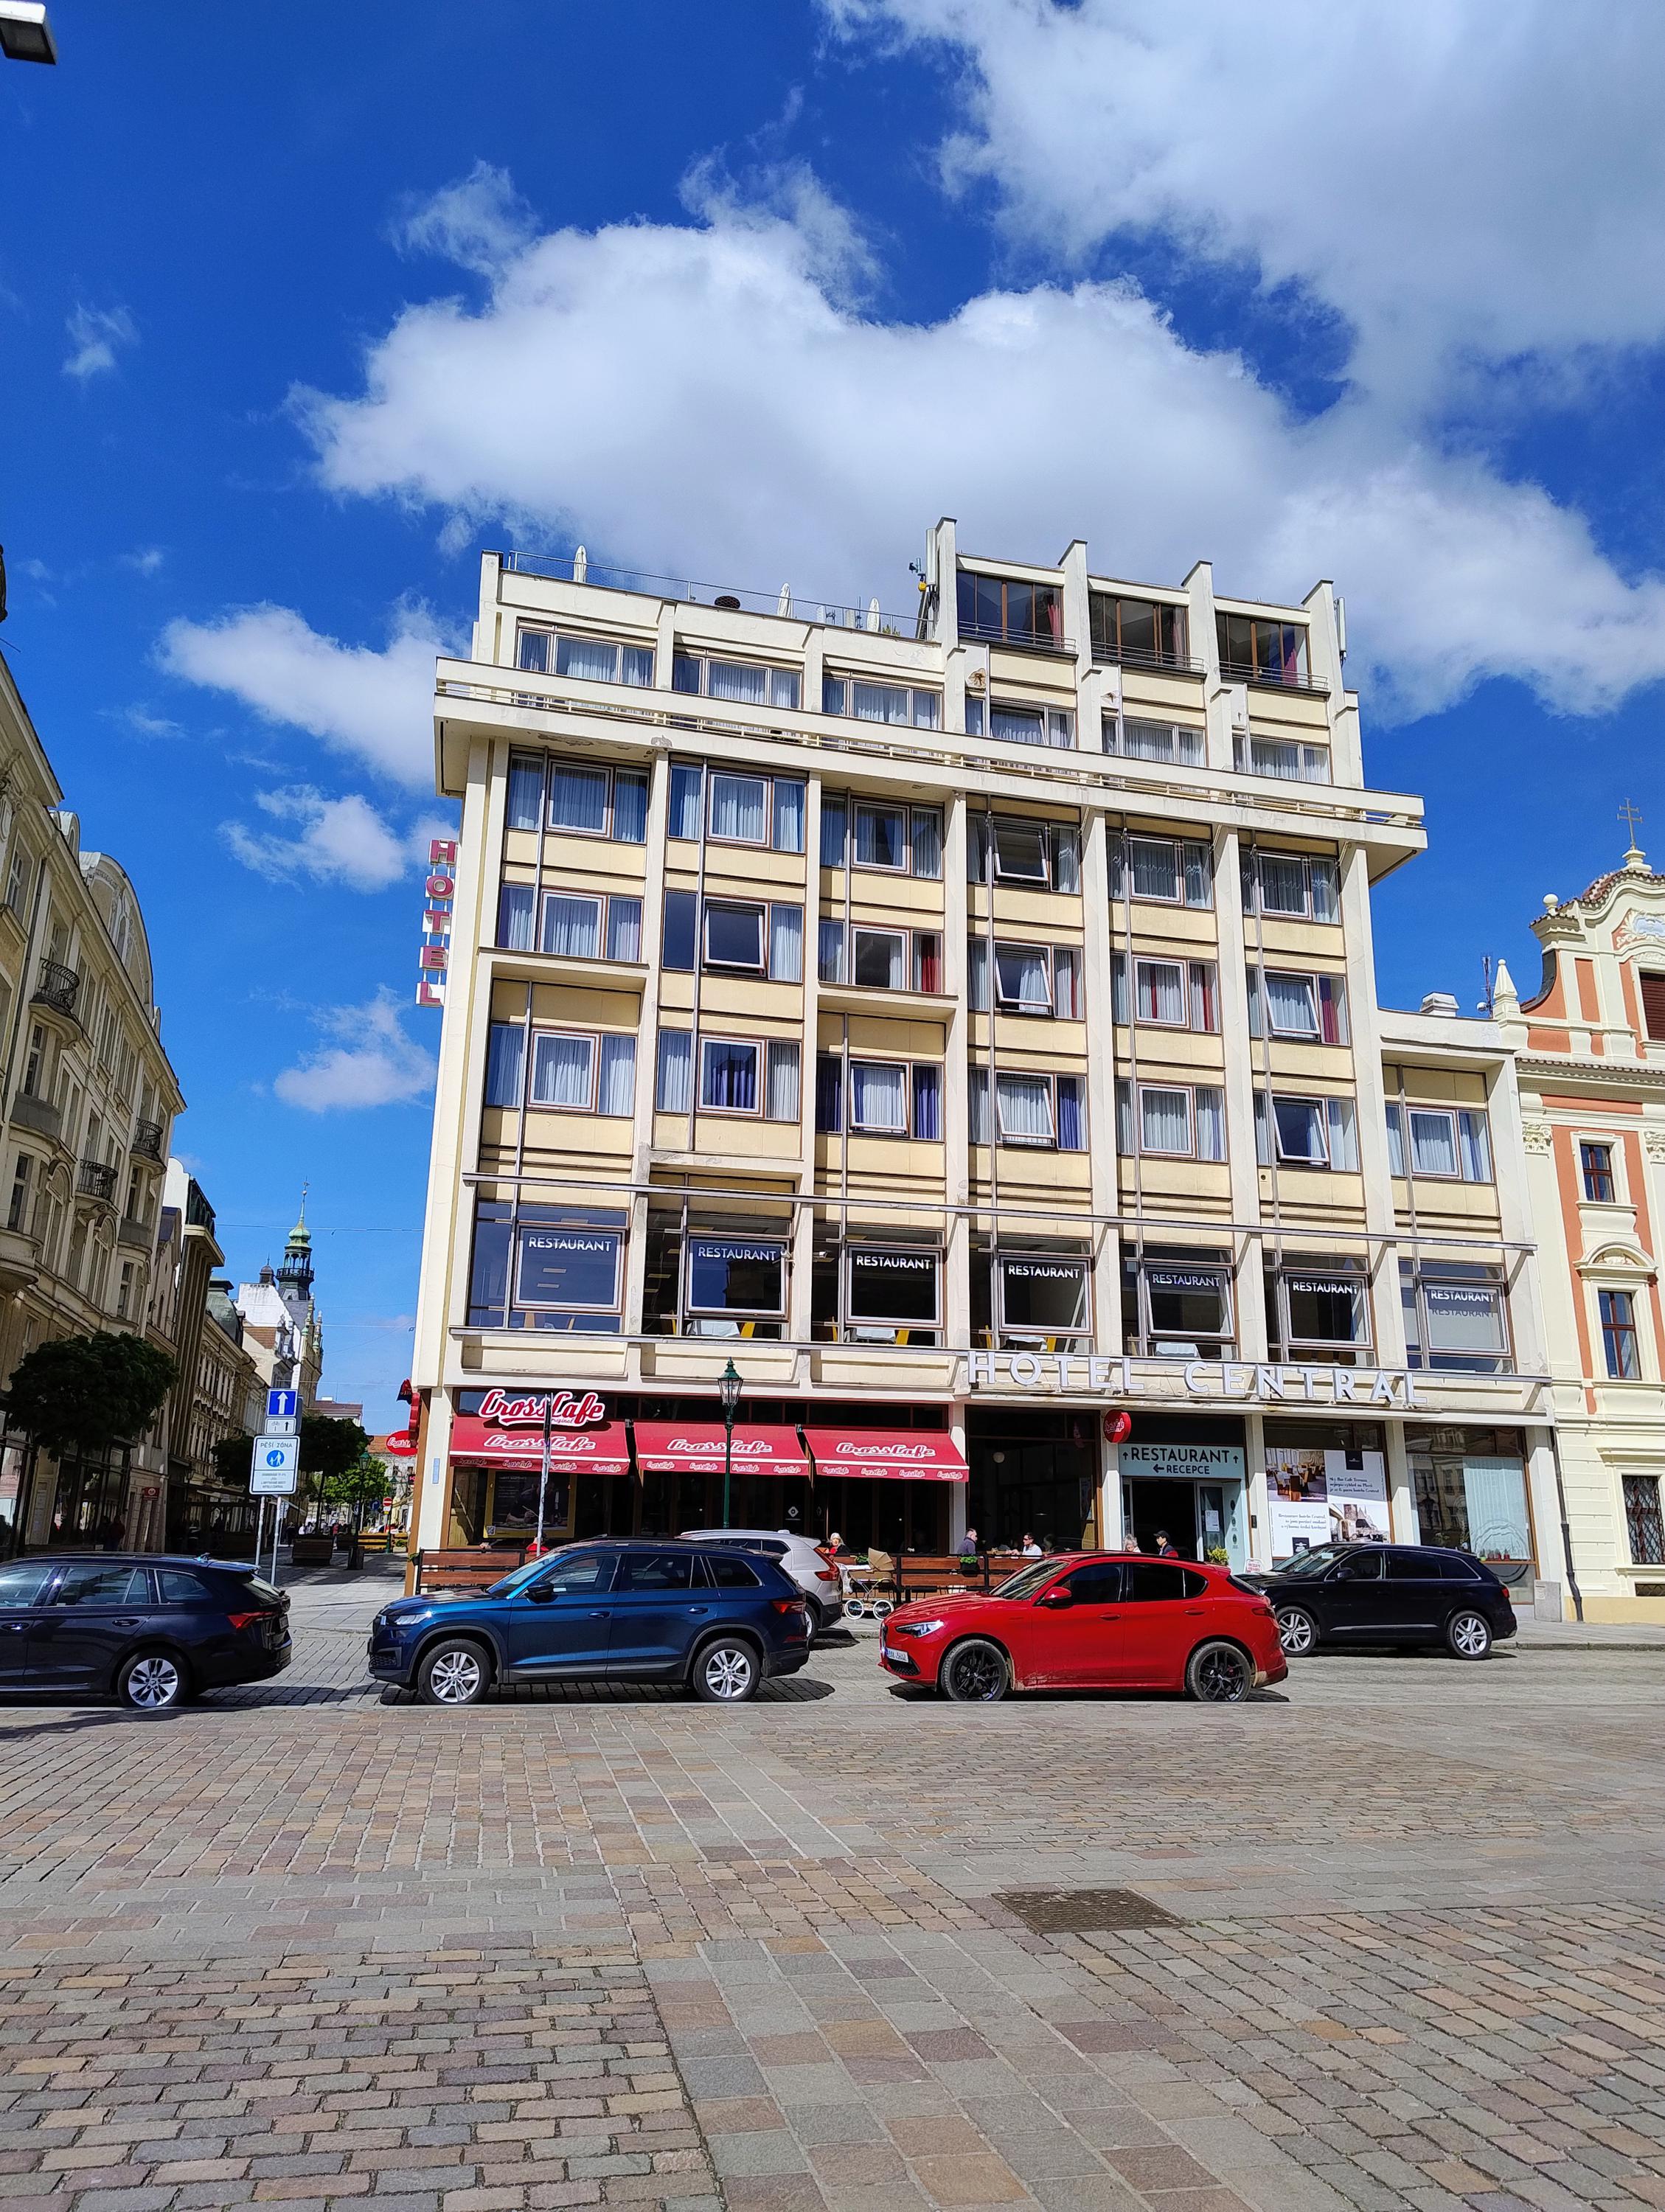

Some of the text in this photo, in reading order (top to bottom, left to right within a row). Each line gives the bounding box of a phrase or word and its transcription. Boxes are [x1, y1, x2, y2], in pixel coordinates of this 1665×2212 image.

[420, 839, 457, 1006] HOTEL
[529, 1237, 611, 1252] RESTAURANT
[698, 1247, 776, 1261] RESTAURANT
[856, 1256, 931, 1269] RESTAURANT
[1008, 1265, 1080, 1279] RESTAURANT
[1153, 1273, 1220, 1287] RESTAURANT
[1293, 1281, 1358, 1295] RESTAURANT
[1431, 1290, 1495, 1303] RESTAURANT
[967, 1351, 1428, 1404] HOTEL CENTRAL
[835, 1442, 936, 1458] CrossCafe
[1131, 1447, 1230, 1463] RESTAURANT
[1167, 1464, 1210, 1475] RECEPCE
